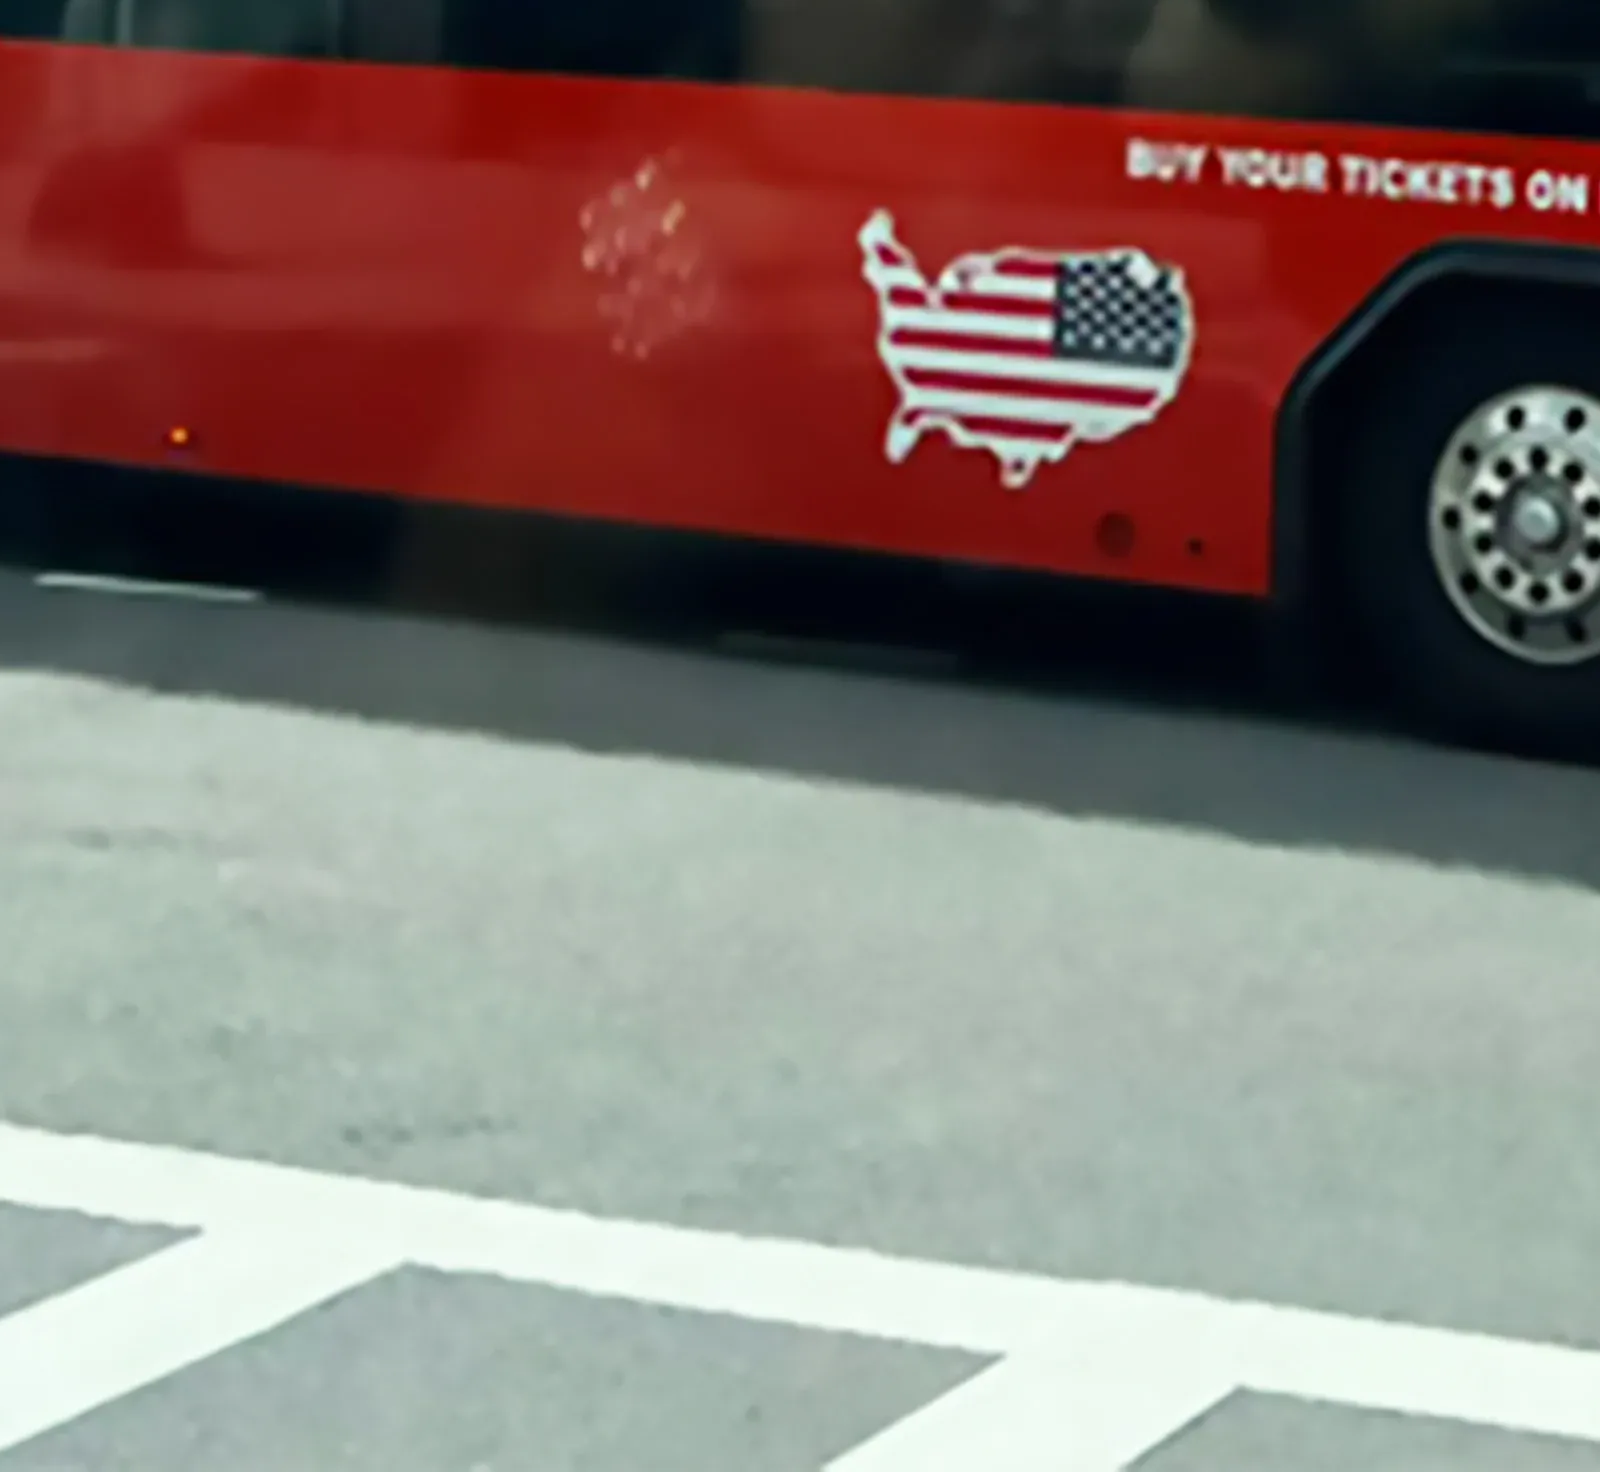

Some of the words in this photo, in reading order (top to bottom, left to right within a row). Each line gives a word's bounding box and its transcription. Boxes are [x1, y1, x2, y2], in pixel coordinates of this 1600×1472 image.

[1125, 138, 1208, 181] BUY
[1218, 146, 1329, 193] YOUR
[1339, 153, 1514, 208] TICKETS
[1526, 169, 1588, 214] ON
